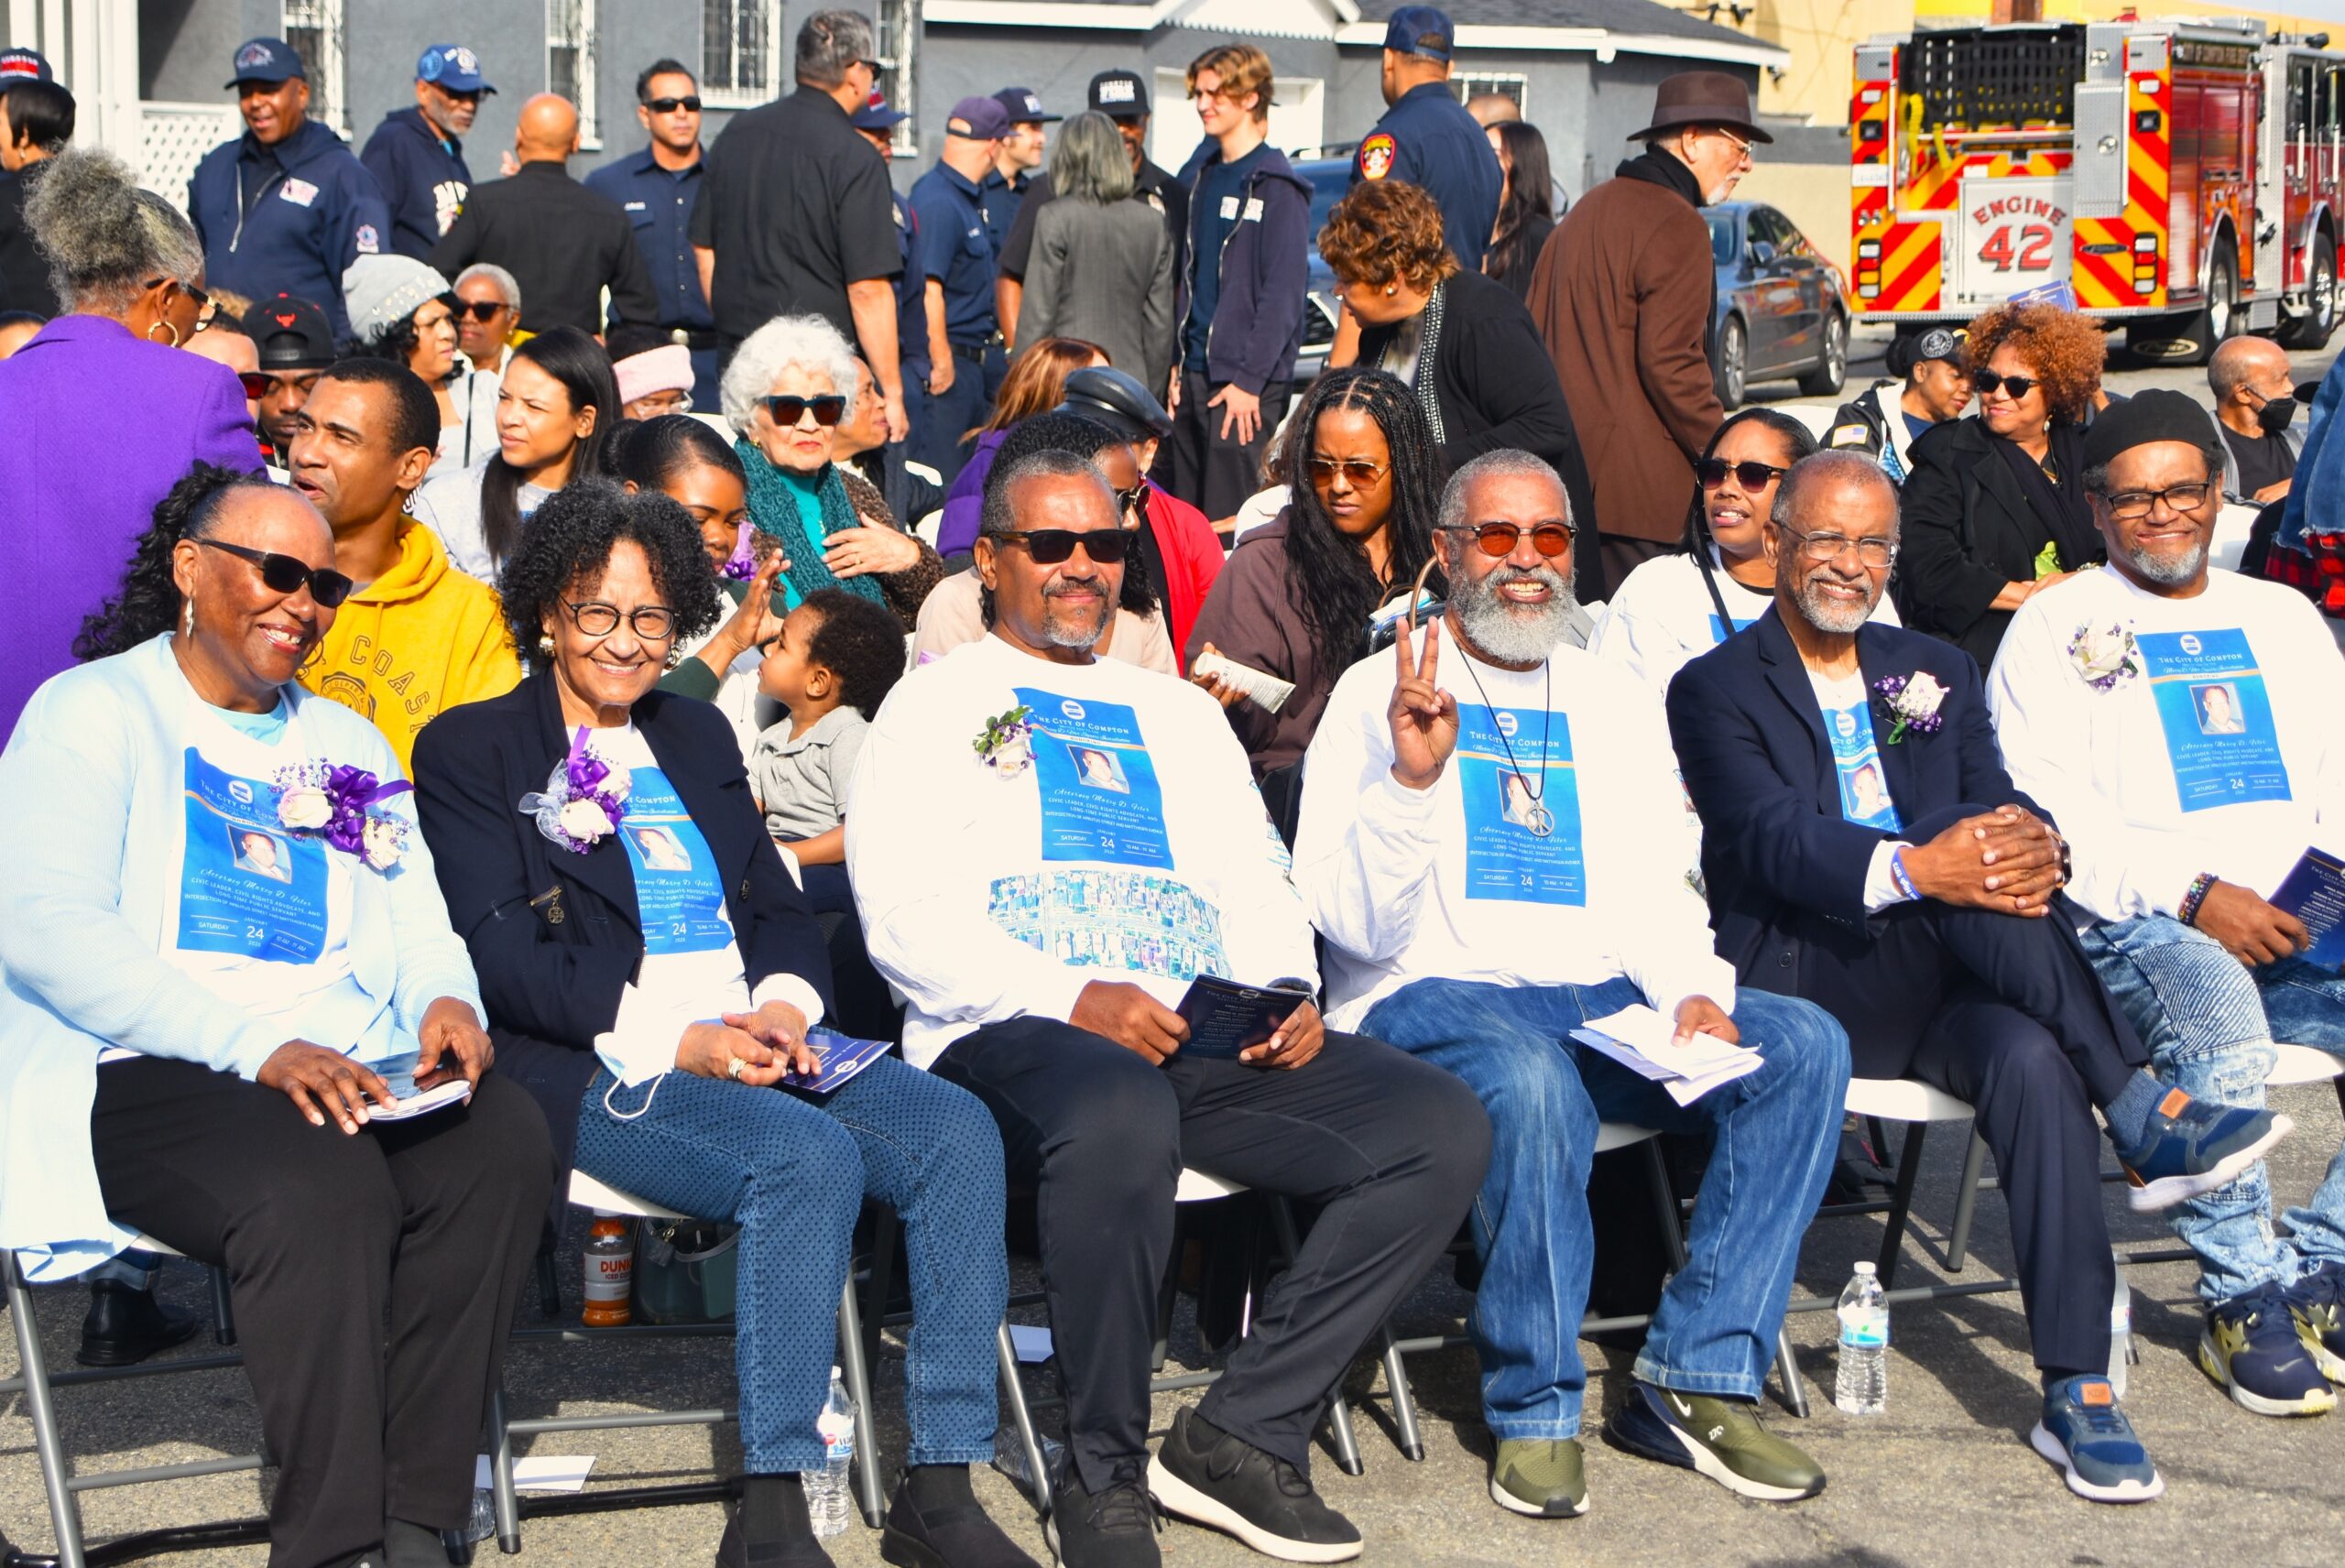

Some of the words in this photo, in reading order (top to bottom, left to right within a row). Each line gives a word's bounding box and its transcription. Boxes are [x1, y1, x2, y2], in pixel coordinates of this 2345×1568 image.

[1973, 196, 2067, 226] ENGINE
[1978, 224, 2053, 272] 42
[2206, 653, 2242, 661] COMPTON
[1034, 715, 1050, 724] THE
[1088, 724, 1129, 735] COMPTON
[1470, 731, 1486, 740] THE
[1489, 735, 1502, 744] CITY
[1847, 736, 1856, 745] OF
[2194, 784, 2219, 792] SATURDAY
[2230, 778, 2244, 789] 24
[201, 779, 214, 797] THE
[217, 793, 236, 807] CITY
[240, 804, 251, 812] OF
[636, 795, 676, 804] COMPTON
[1054, 788, 1090, 800] Attorney
[1118, 814, 1140, 823] SERVANT
[1101, 836, 1115, 848] 24
[200, 869, 242, 886] Attorney
[2310, 866, 2323, 876] THE
[2324, 872, 2339, 881] CITY
[1521, 874, 1533, 887] 24
[1900, 877, 1913, 894] High
[184, 894, 222, 903] INTERSECTION
[191, 877, 209, 886] CIVIC
[211, 881, 234, 894] LEADER,
[234, 888, 249, 898] CIVIL
[251, 894, 274, 905] RIGHTS
[275, 900, 306, 914] ADVOCATE,
[249, 899, 270, 909] PUBLIC
[271, 906, 297, 917] SERVANT
[198, 921, 229, 931] SATURDAY
[244, 916, 267, 926] JANUARY
[246, 925, 265, 940] 24
[672, 922, 687, 935] 24
[297, 943, 307, 953] AM
